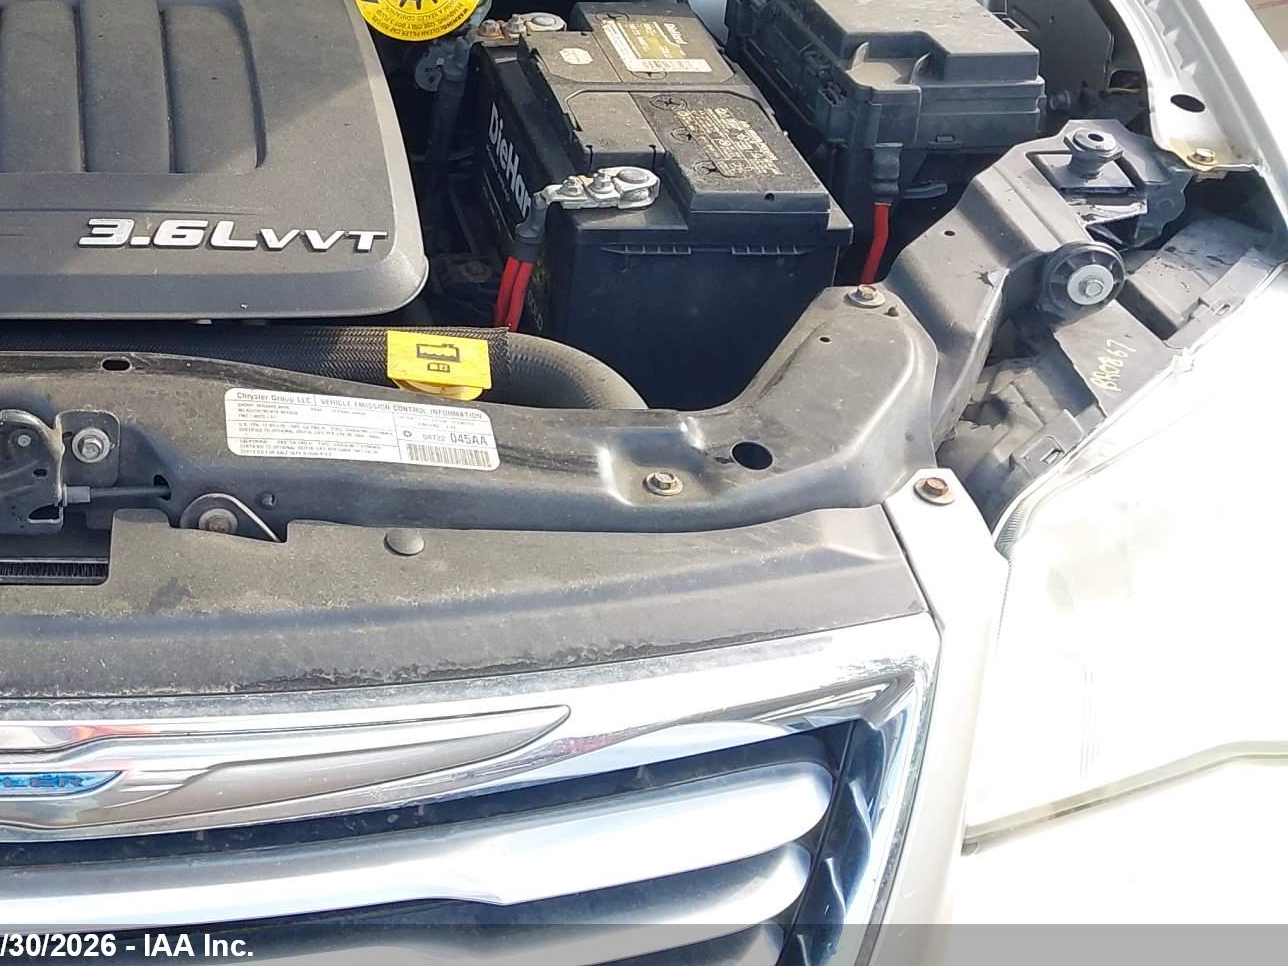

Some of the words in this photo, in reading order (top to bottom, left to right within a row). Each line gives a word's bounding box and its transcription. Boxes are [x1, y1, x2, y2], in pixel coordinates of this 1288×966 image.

[489, 101, 531, 218] DieHar
[236, 392, 269, 402] Chrysler
[271, 394, 295, 404] Group
[320, 399, 351, 408] VEHICLE
[354, 401, 390, 411] EMISSION
[393, 404, 427, 415] CONTROL
[430, 409, 483, 420] INFORMATION
